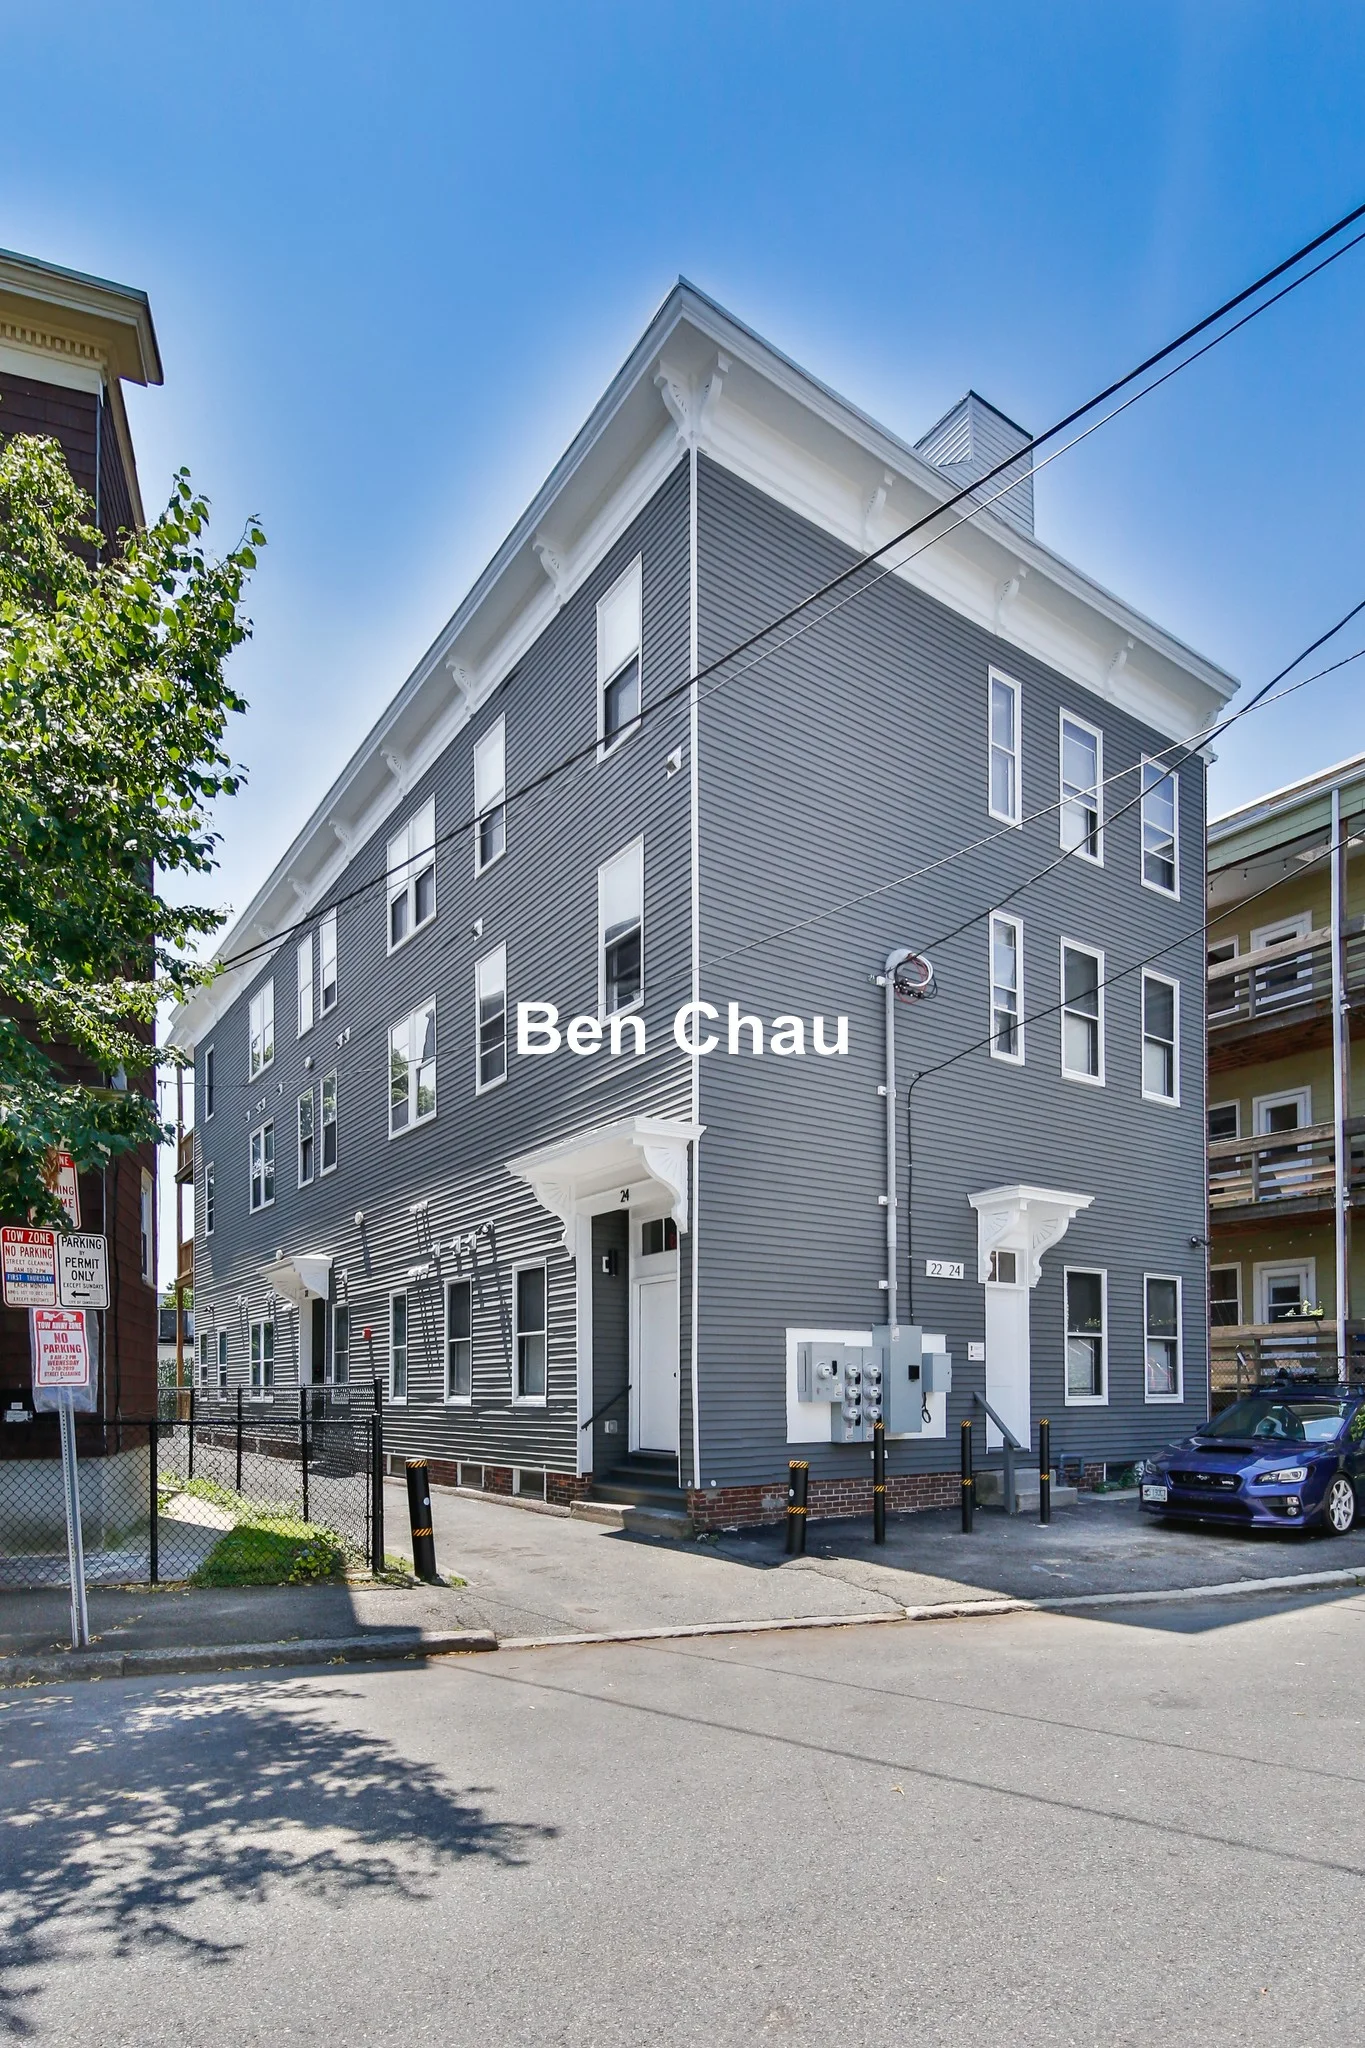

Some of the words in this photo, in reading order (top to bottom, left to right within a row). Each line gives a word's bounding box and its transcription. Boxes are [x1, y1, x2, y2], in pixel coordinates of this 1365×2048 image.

[620, 1188, 629, 1202] 24
[5, 1230, 24, 1242] TOW
[28, 1232, 51, 1245] ZONE
[61, 1236, 102, 1250] PARKING
[5, 1245, 16, 1257] NO
[20, 1246, 52, 1259] PARKING
[65, 1256, 100, 1269] PERMIT
[71, 1269, 95, 1281] ONLY
[931, 1263, 942, 1275] 22
[949, 1264, 960, 1276] 24
[7, 1273, 22, 1281] FIRST
[26, 1274, 53, 1282] THURSDAY
[37, 1321, 50, 1329] TOW
[54, 1333, 68, 1343] NO
[43, 1344, 82, 1353] PARKING
